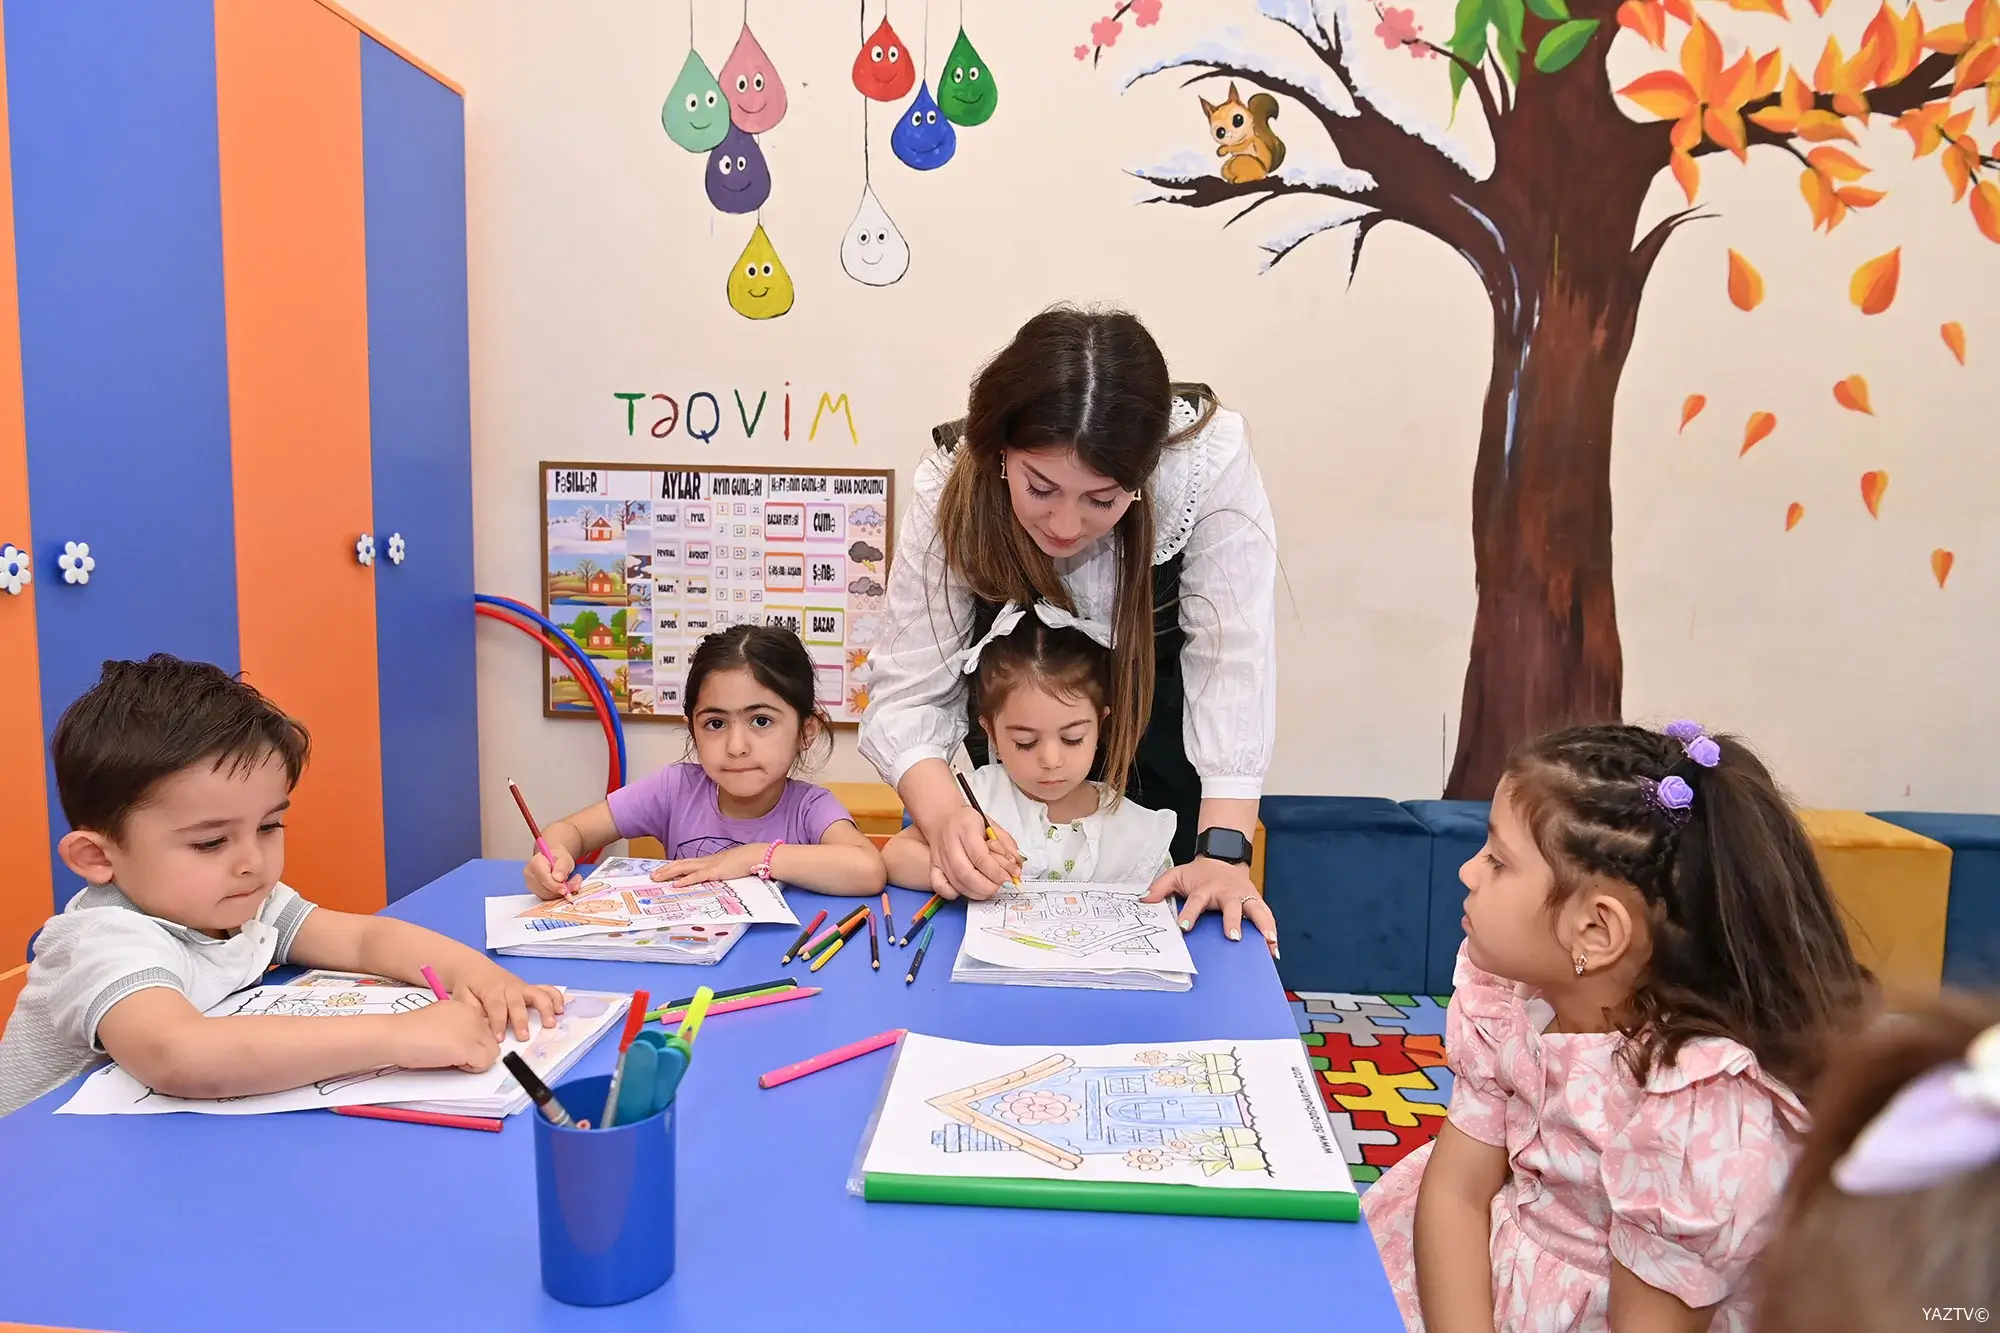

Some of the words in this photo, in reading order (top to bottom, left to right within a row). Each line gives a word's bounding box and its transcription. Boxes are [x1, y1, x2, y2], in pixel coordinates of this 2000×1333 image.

[661, 471, 701, 500] AYLAR
[833, 479, 852, 495] HAVA
[853, 479, 884, 495] DURUMU
[813, 616, 836, 633] BAZAR
